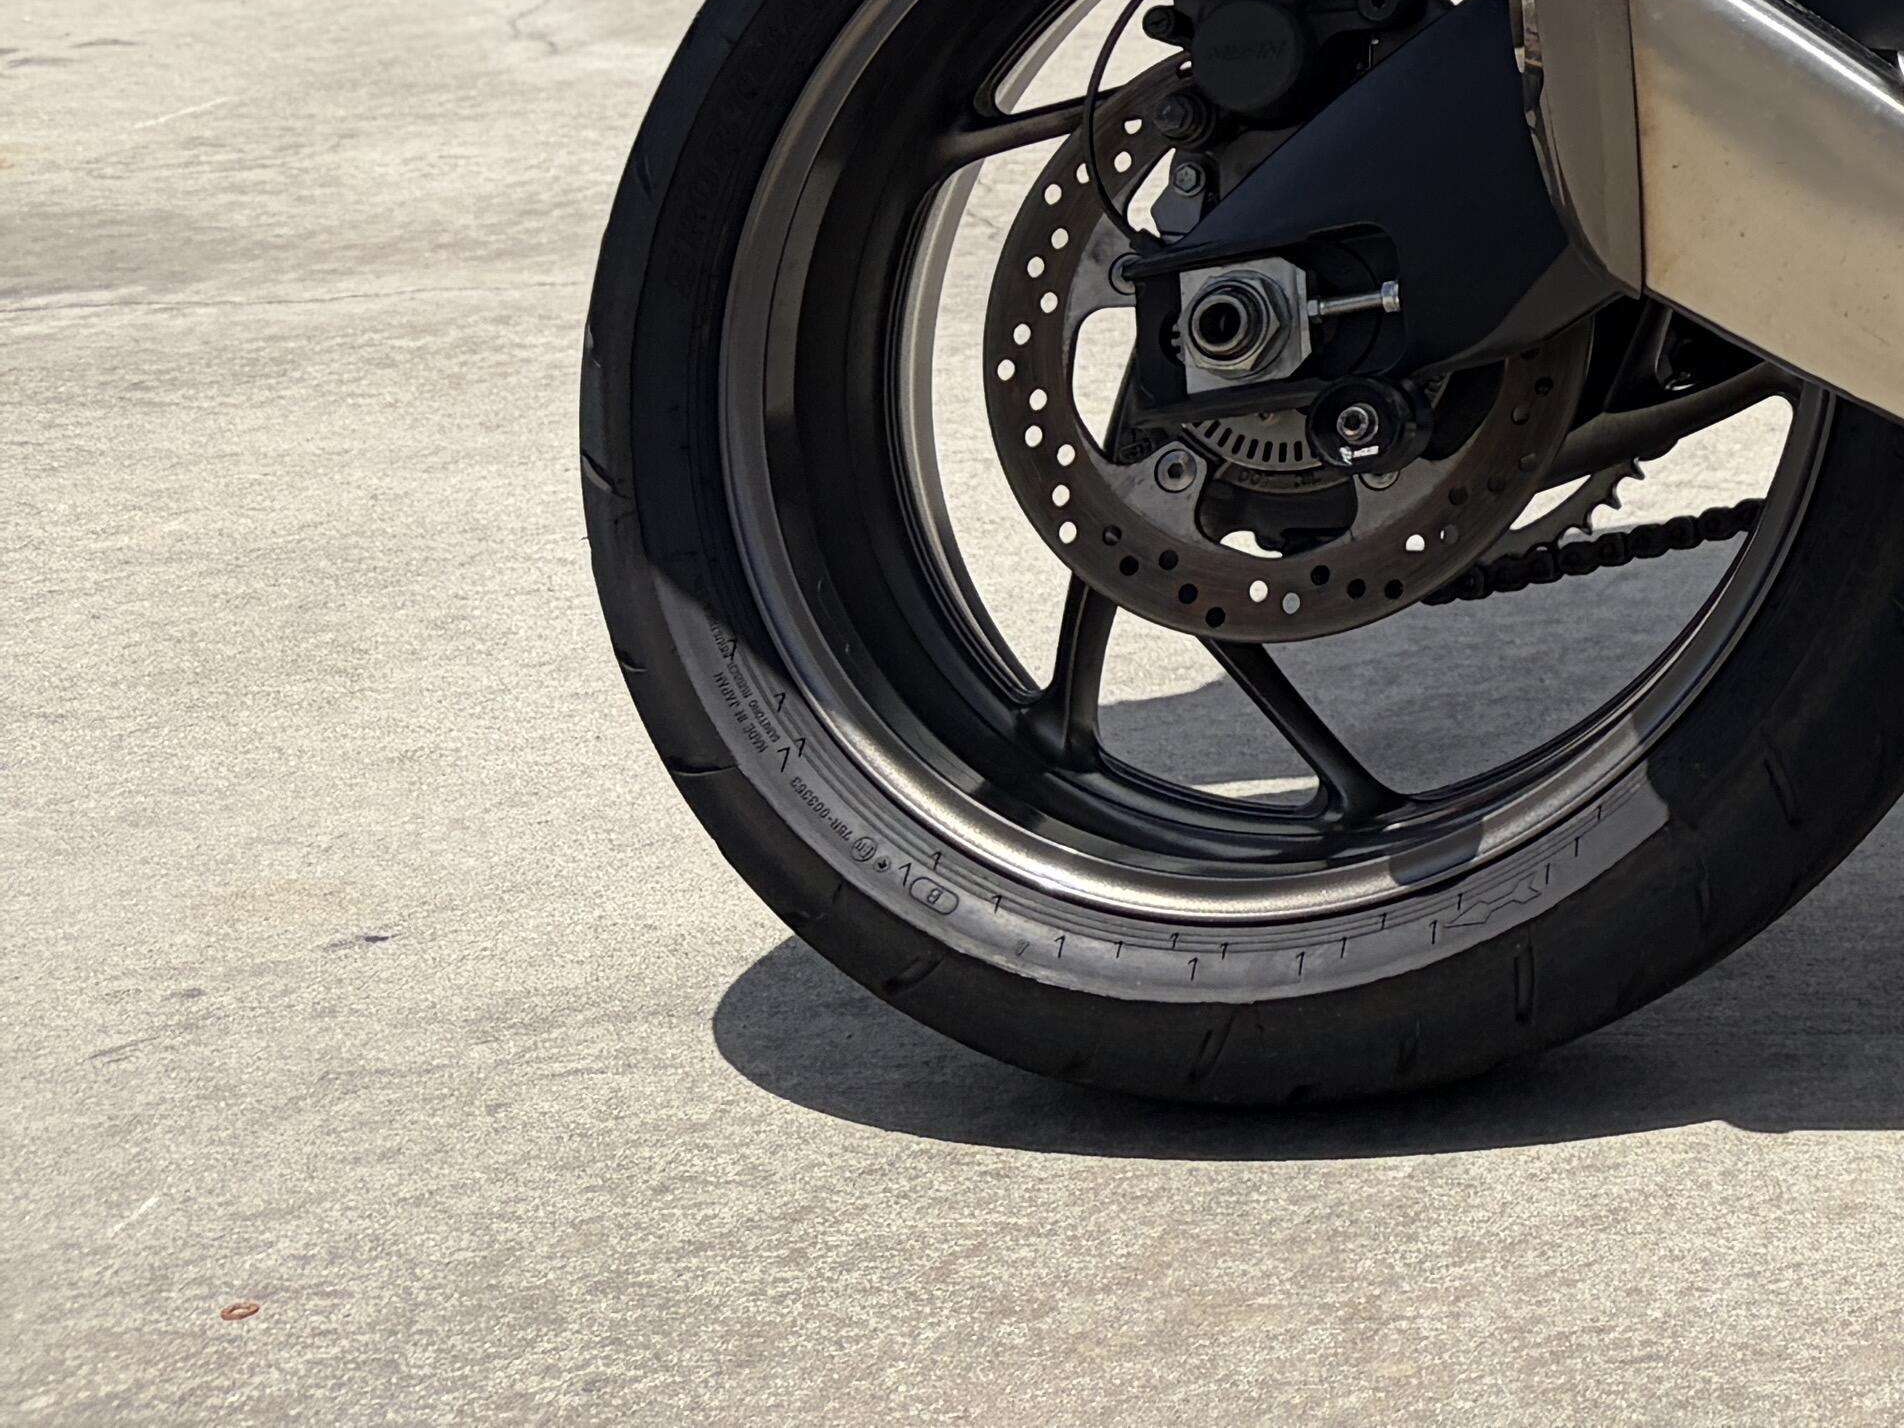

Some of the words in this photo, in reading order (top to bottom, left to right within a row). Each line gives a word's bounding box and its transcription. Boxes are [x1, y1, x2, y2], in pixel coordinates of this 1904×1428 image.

[713, 670, 742, 709] JAPAN
[742, 722, 769, 754] MADE
[926, 887, 944, 906] B
